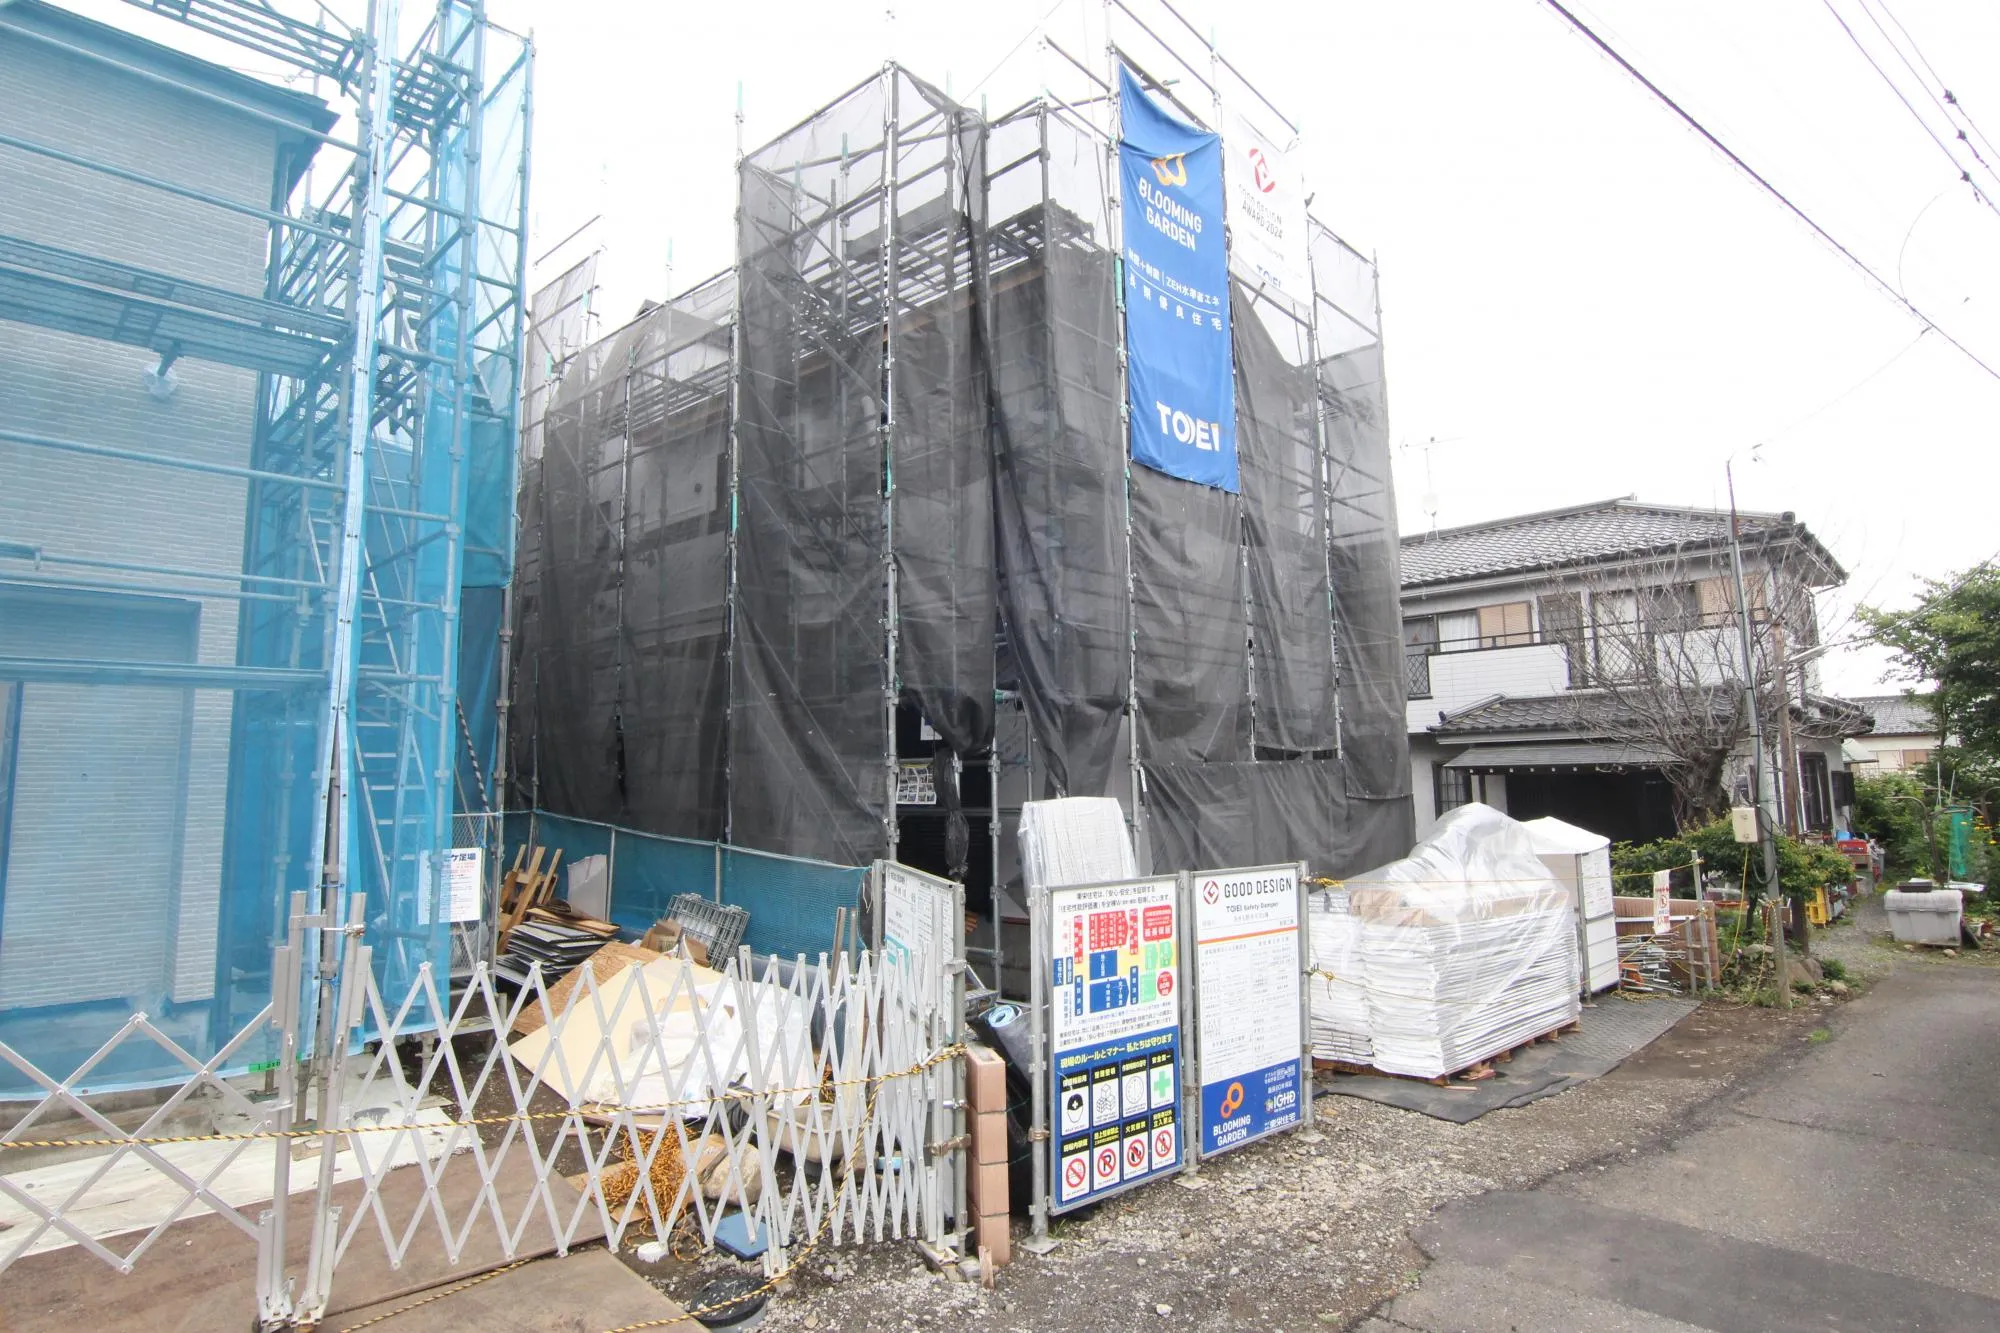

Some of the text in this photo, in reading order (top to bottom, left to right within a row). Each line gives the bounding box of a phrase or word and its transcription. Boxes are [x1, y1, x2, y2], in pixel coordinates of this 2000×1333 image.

[1138, 176, 1202, 234] BLOOMING
[1242, 199, 1283, 240] AWARD 2024
[1145, 205, 1197, 252] GARDEN
[1156, 400, 1221, 453] TOEI
[1224, 877, 1293, 899] GOOD DESIGN
[1213, 1114, 1252, 1137] BLOOMING
[1217, 1127, 1248, 1147] GARDEN
